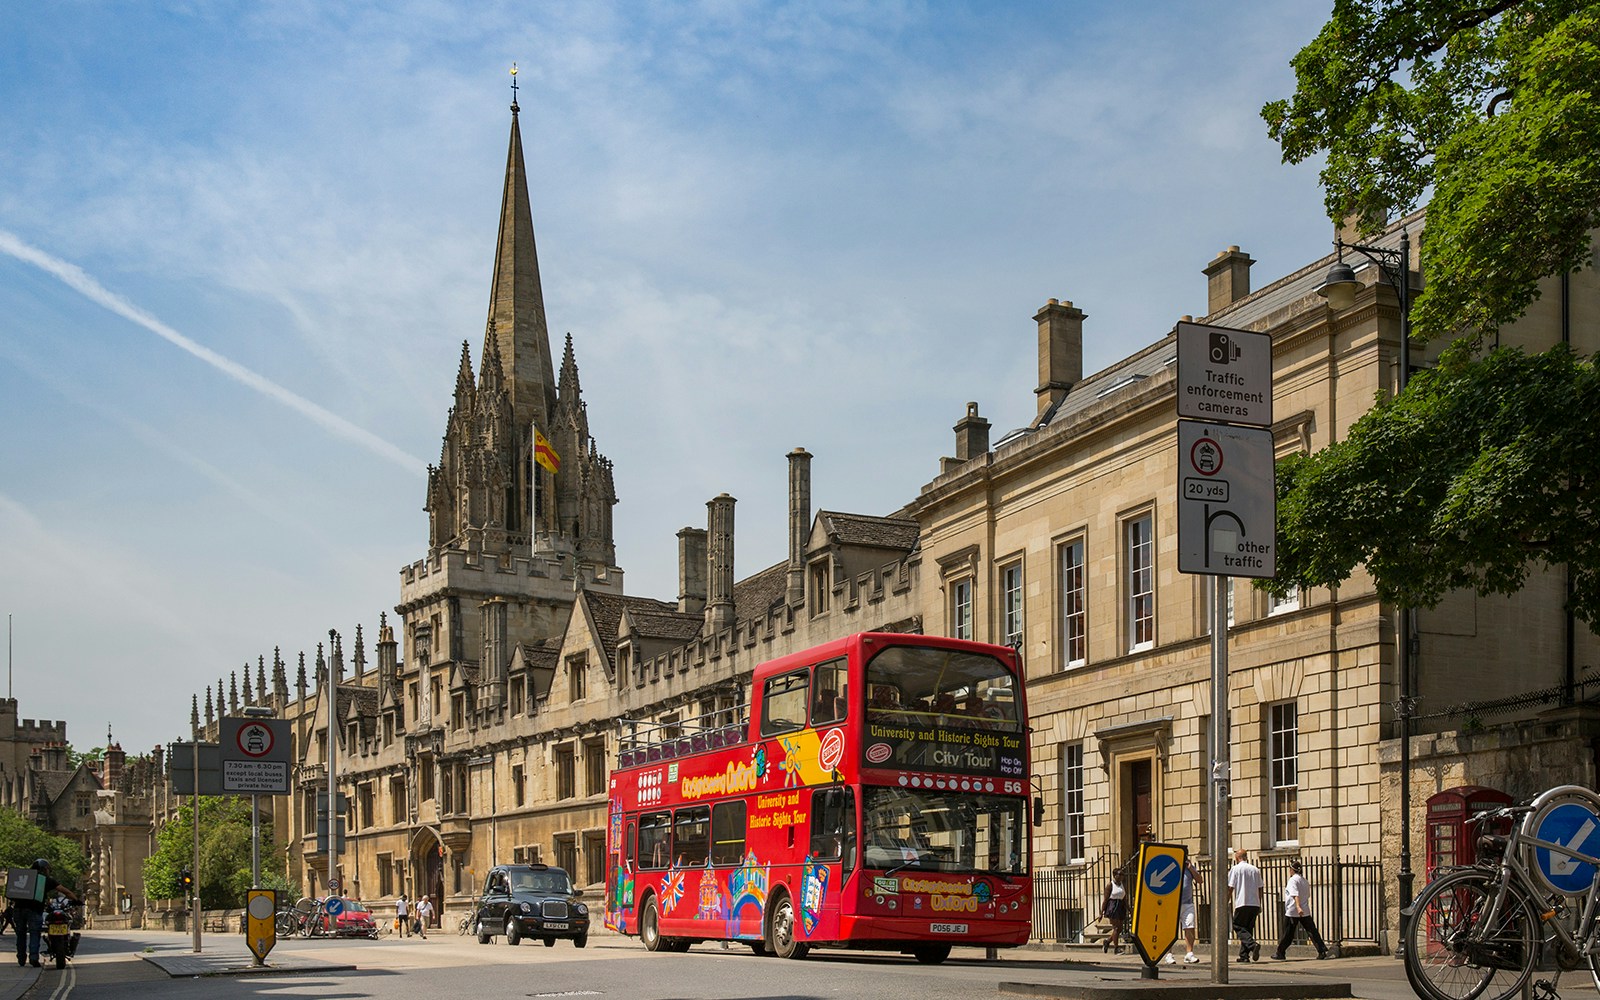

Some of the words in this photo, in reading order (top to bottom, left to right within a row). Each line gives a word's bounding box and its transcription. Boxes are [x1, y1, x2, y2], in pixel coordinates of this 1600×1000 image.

[1205, 370, 1245, 386] Traffic
[1187, 384, 1264, 404] enforcement
[1198, 402, 1249, 416] cameras
[1189, 483, 1203, 494] 20
[1206, 485, 1224, 496] yds
[1238, 541, 1270, 554] other
[1224, 554, 1263, 568] traffic
[871, 725, 915, 741] University
[918, 730, 935, 741] and
[938, 731, 971, 744] Historic
[973, 734, 1000, 748] Sights
[1002, 736, 1020, 748] Tour
[933, 750, 960, 766] City
[964, 752, 992, 768] Tour
[1001, 756, 1012, 765] Hop
[1013, 758, 1022, 766] On
[1000, 765, 1012, 774] Hop
[1012, 766, 1023, 775] Off
[726, 761, 757, 795] Oxford
[1003, 780, 1022, 793] 56
[757, 794, 786, 809] University
[788, 790, 800, 806] and
[749, 814, 772, 829] Historic
[772, 811, 791, 829] Sights
[793, 809, 807, 824] Tour
[930, 894, 978, 912] Oxford
[932, 924, 951, 932] PO56
[952, 925, 967, 933] JEJ
